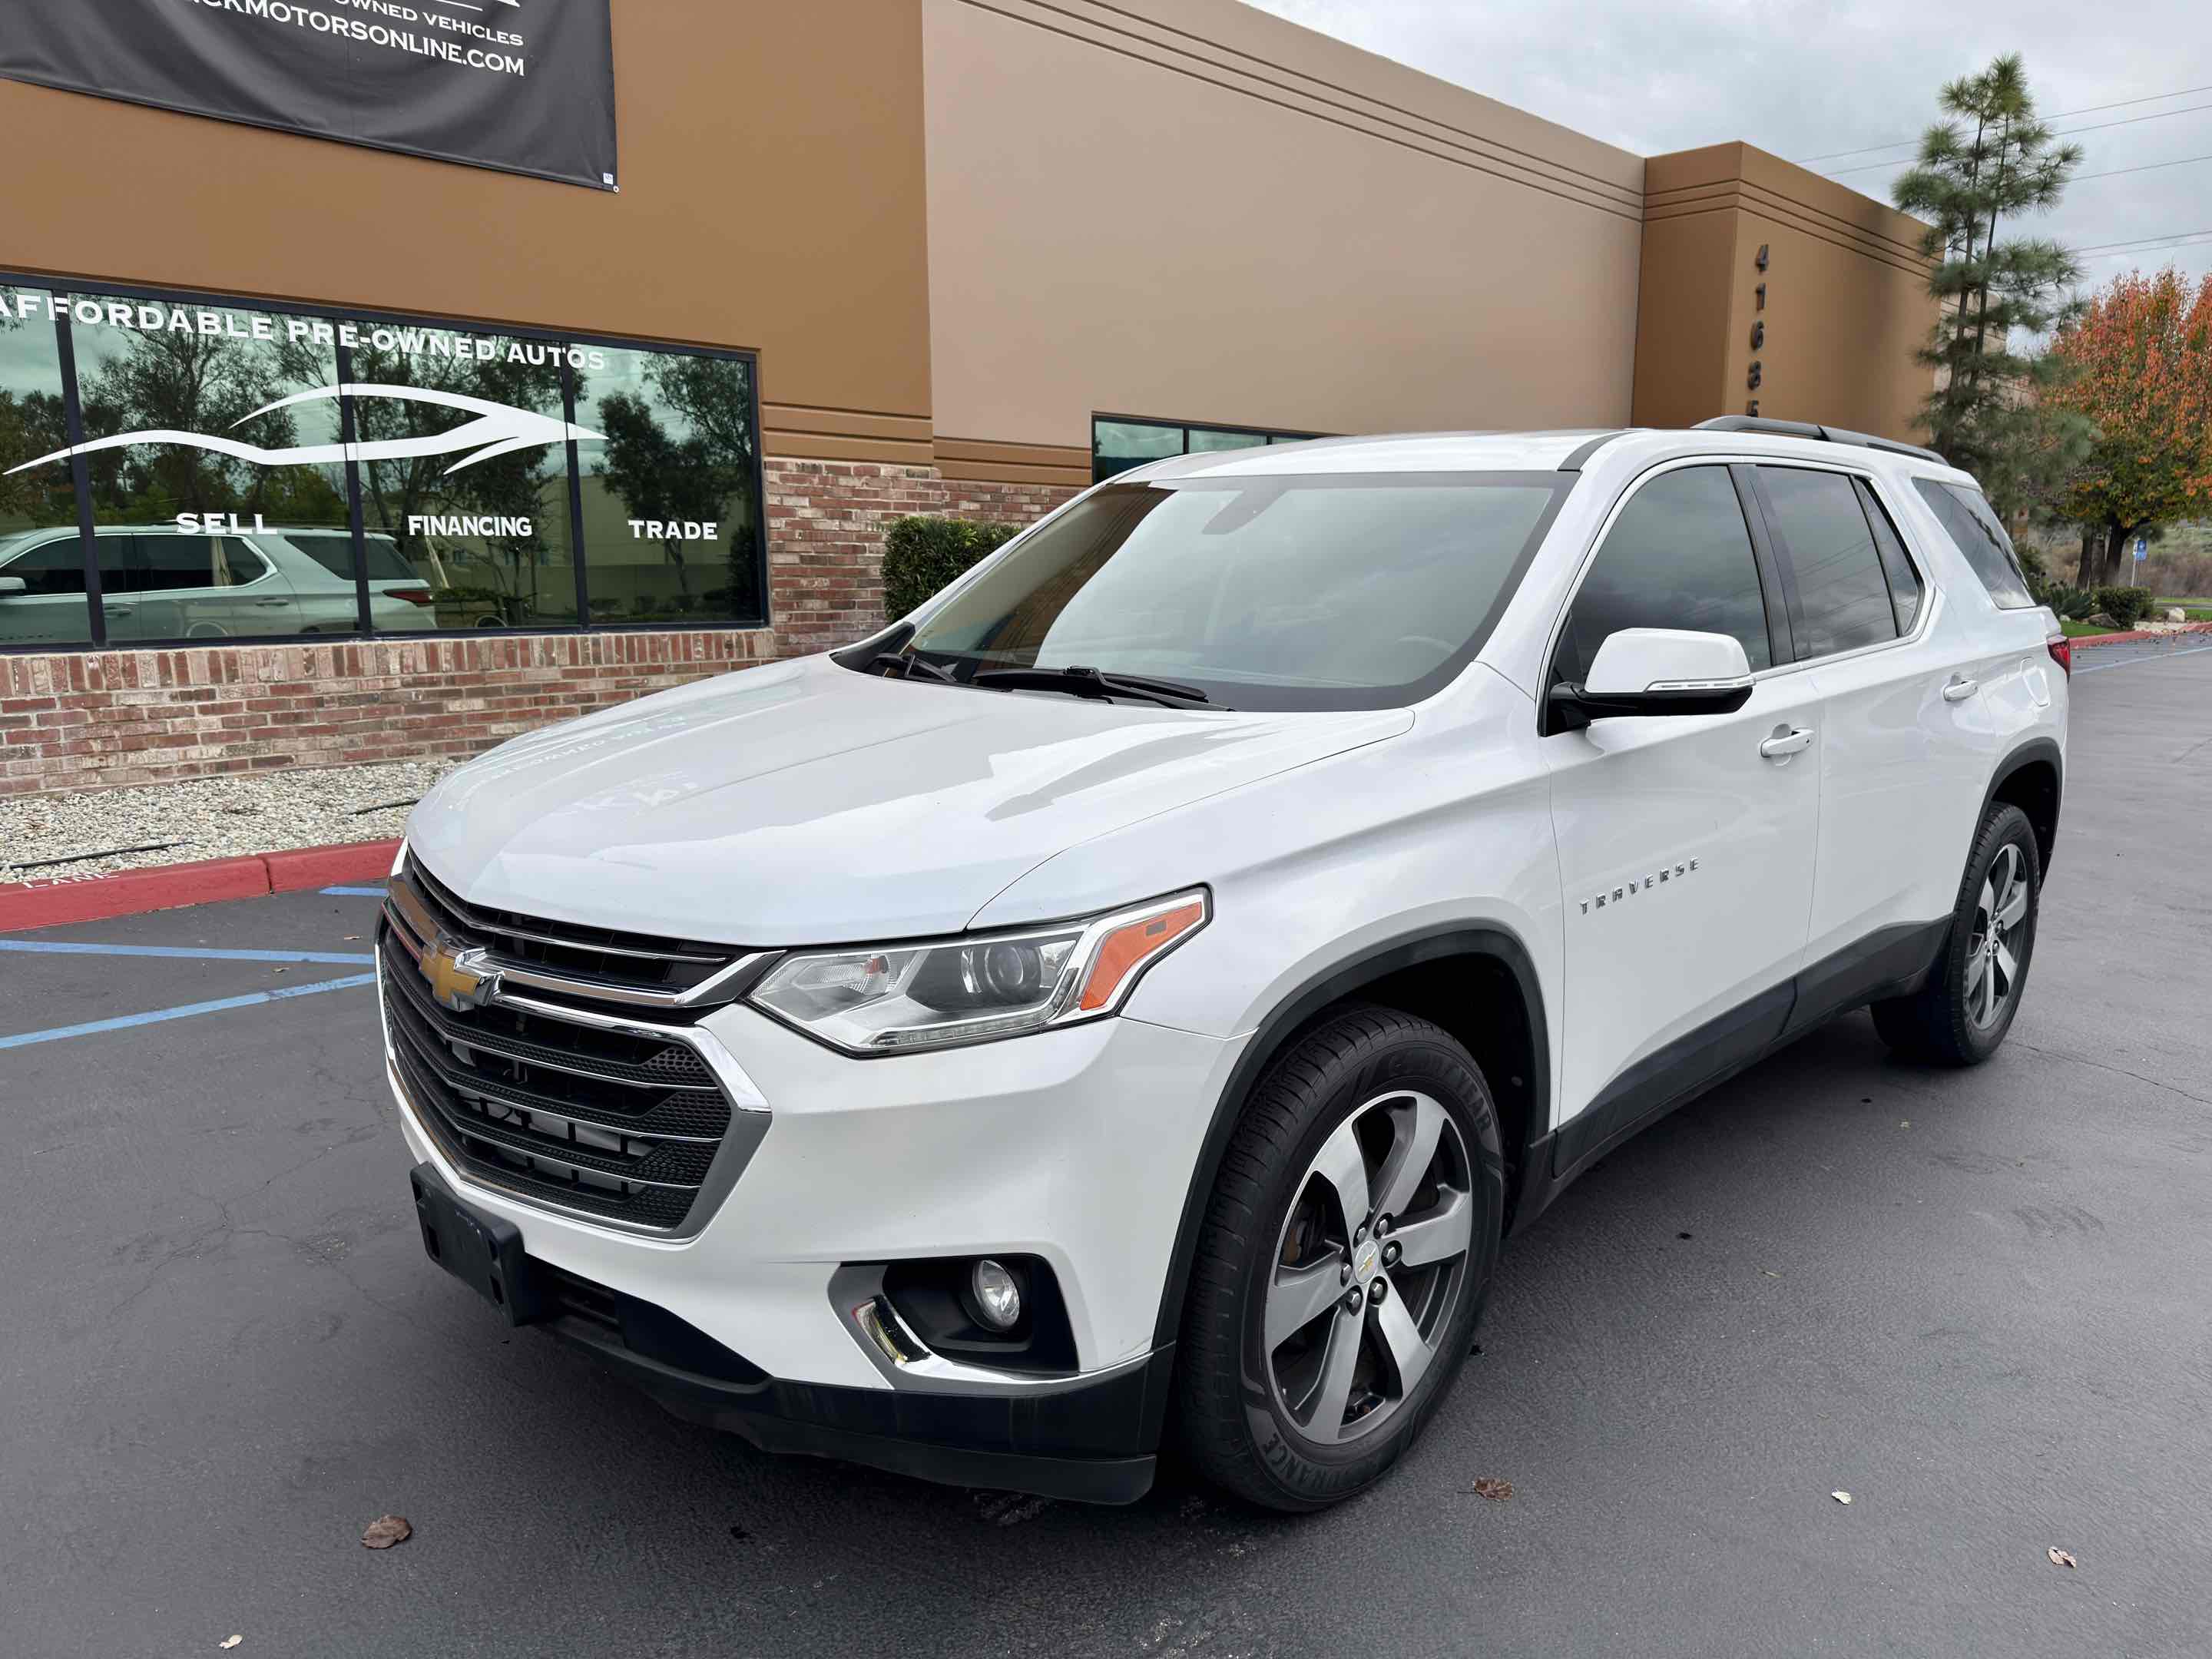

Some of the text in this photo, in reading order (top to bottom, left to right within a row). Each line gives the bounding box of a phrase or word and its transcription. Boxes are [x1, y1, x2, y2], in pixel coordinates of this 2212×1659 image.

[422, 12, 524, 46] VEHICLES
[288, 320, 496, 361] PRE-OWNED
[507, 343, 603, 370] AUTOS
[176, 512, 277, 535] SELL
[407, 515, 533, 537] FINANCING
[628, 520, 718, 541] TRADE
[1579, 854, 1700, 916] TRAVERSE
